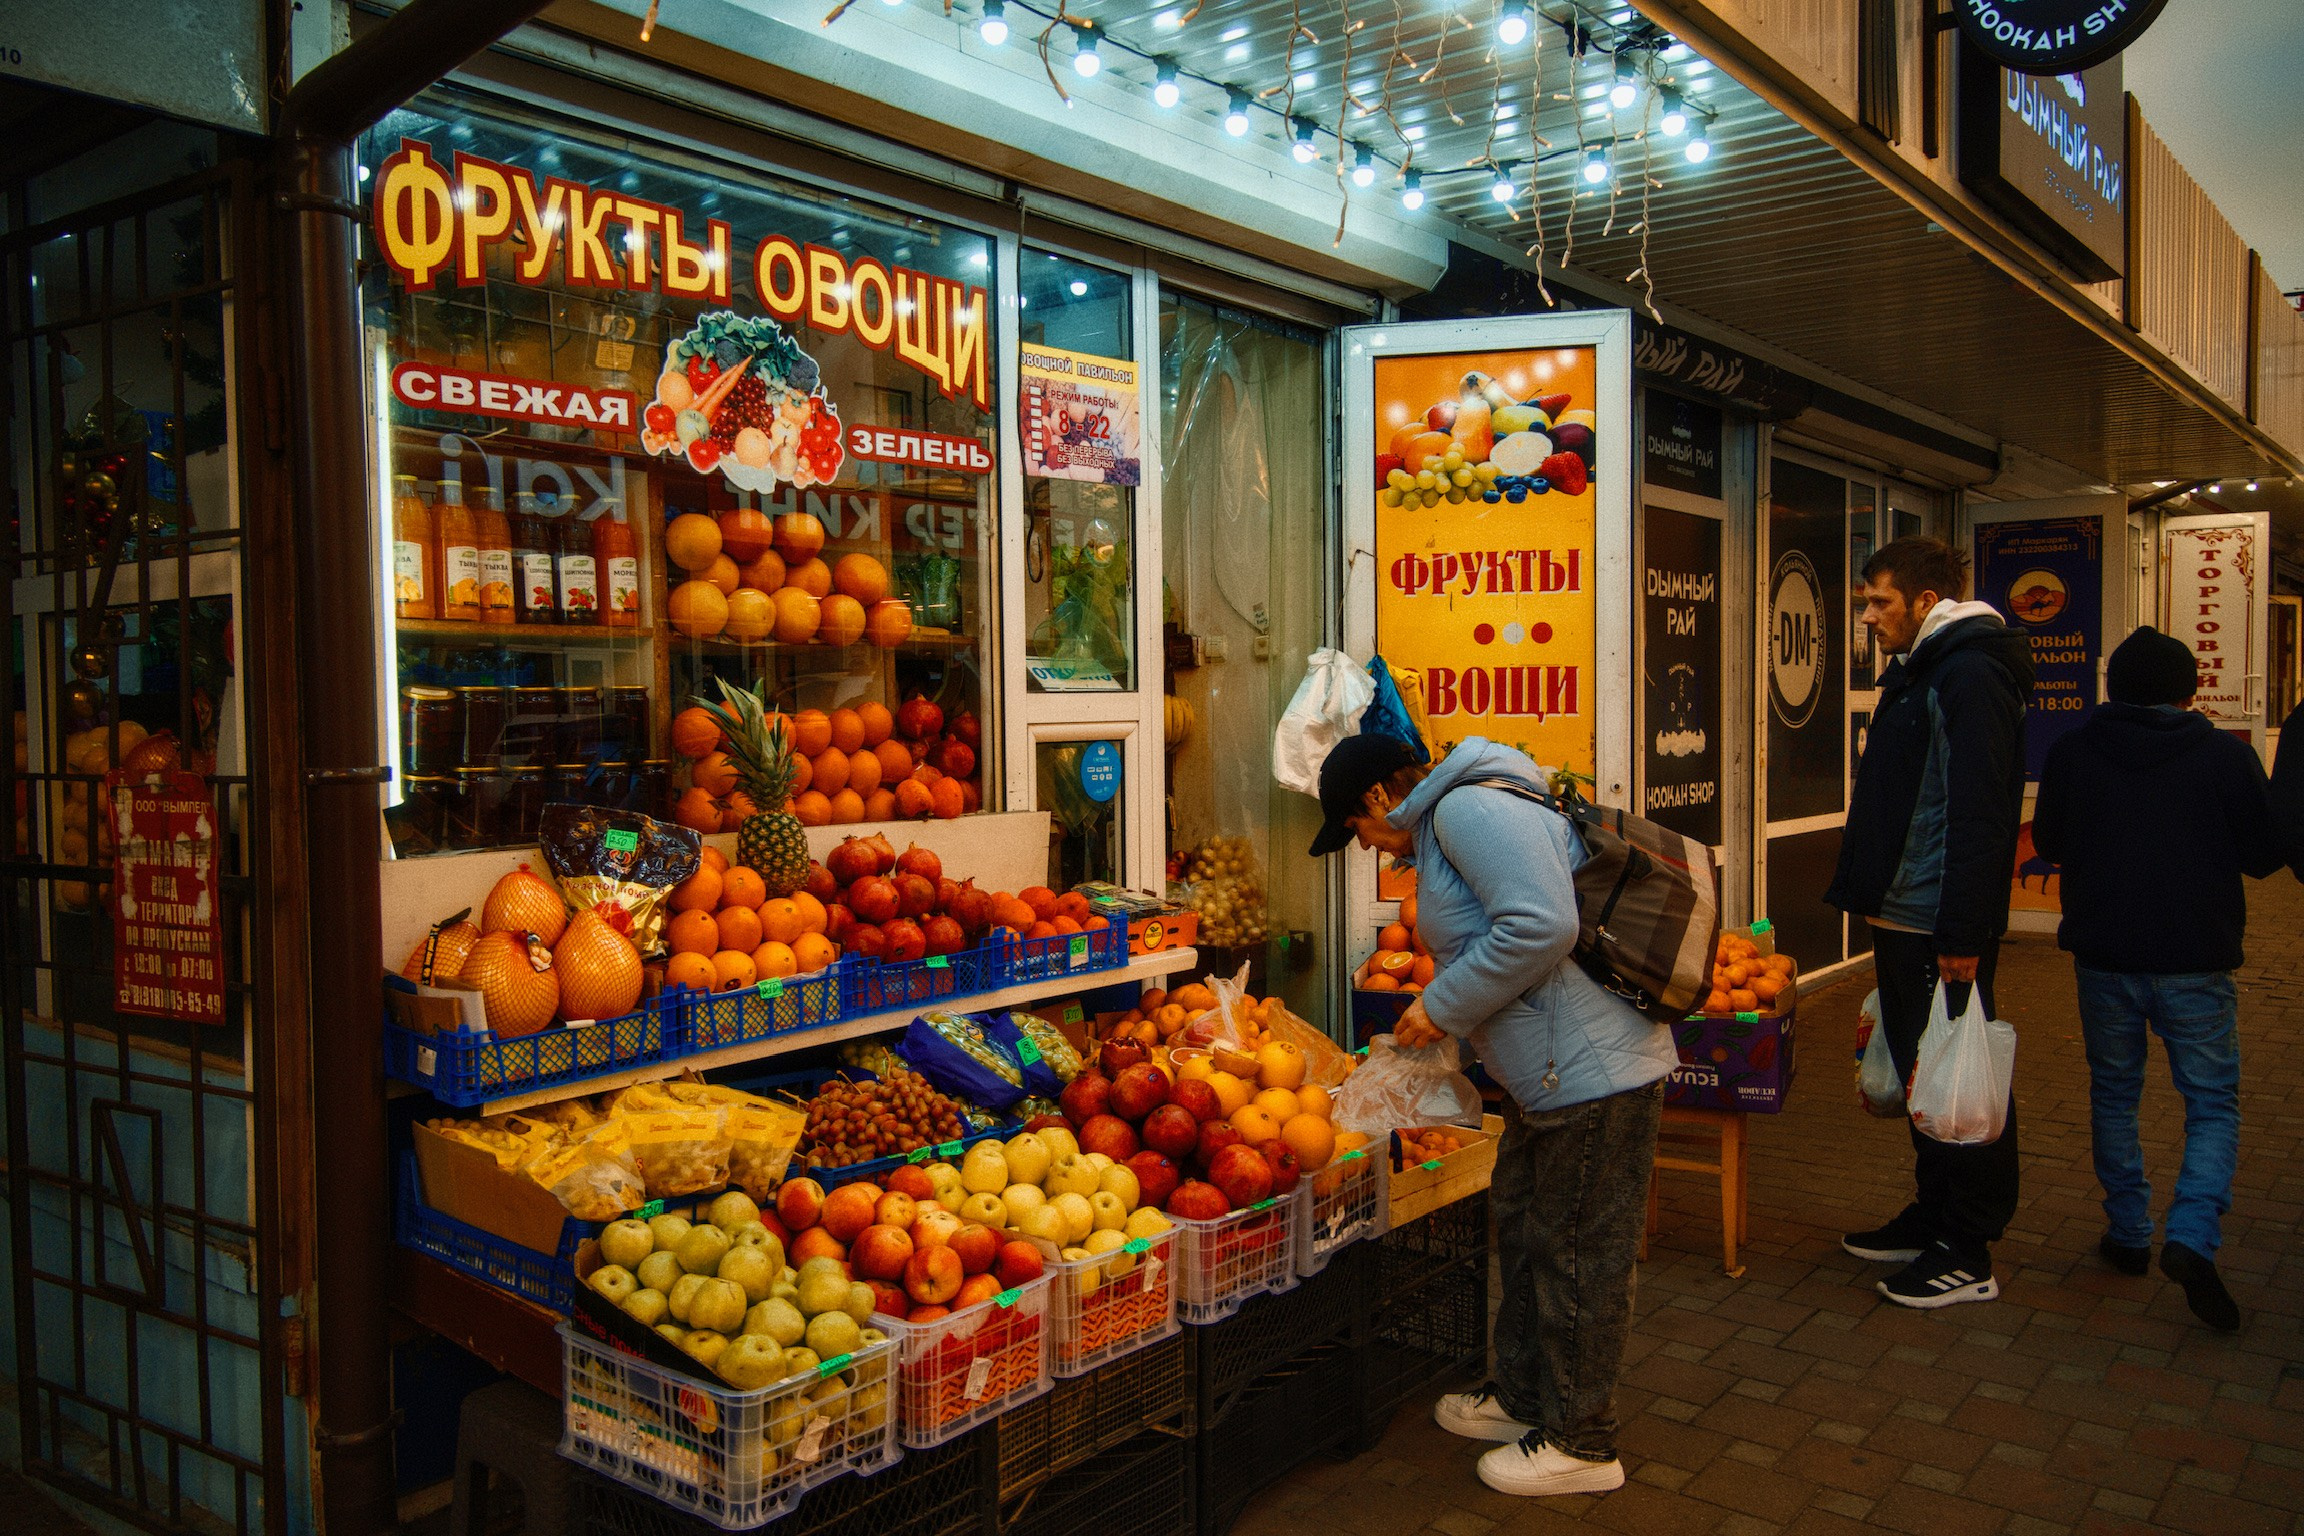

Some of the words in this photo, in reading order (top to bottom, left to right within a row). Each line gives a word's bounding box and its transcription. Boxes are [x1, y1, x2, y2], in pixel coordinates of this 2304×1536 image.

[1968, 0, 2076, 50] HOOKAH
[2083, 0, 2129, 36] SH
[2093, 144, 2122, 214] РАЙ
[378, 145, 729, 299] ФРУКТЫ
[757, 238, 987, 409] ОВОЩИ
[1077, 362, 1133, 384] ПАВИЛЬОН
[1681, 350, 1744, 395] РАЙ
[399, 370, 630, 426] СВЕЖАЯ
[1051, 389, 1081, 405] РЕЖИМ
[1083, 395, 1119, 410] РАБОТЫ:
[1059, 410, 1070, 434] 8
[1088, 414, 1111, 439] 22
[852, 429, 991, 469] ЗЕЛЕНЬ
[1057, 455, 1072, 465] БЕЗ
[1073, 456, 1116, 469] ВЫХОДНЫХ
[1058, 442, 1073, 453] БЕЗ
[1074, 444, 1115, 459] ПЕРЕРЫВА
[1696, 449, 1714, 469] РАЙ
[459, 560, 478, 568] ТЫКВ
[1391, 549, 1582, 597] ФРУКТЫ
[1667, 606, 1696, 637] РАЙ
[2030, 631, 2085, 648] ОВЫЙ
[1405, 666, 1580, 726] ВОЩИ
[135, 800, 157, 812] ООО
[1646, 784, 1688, 811] HOOKAH
[1689, 782, 1715, 805] SHOP
[1665, 1070, 1719, 1087] ECUA
